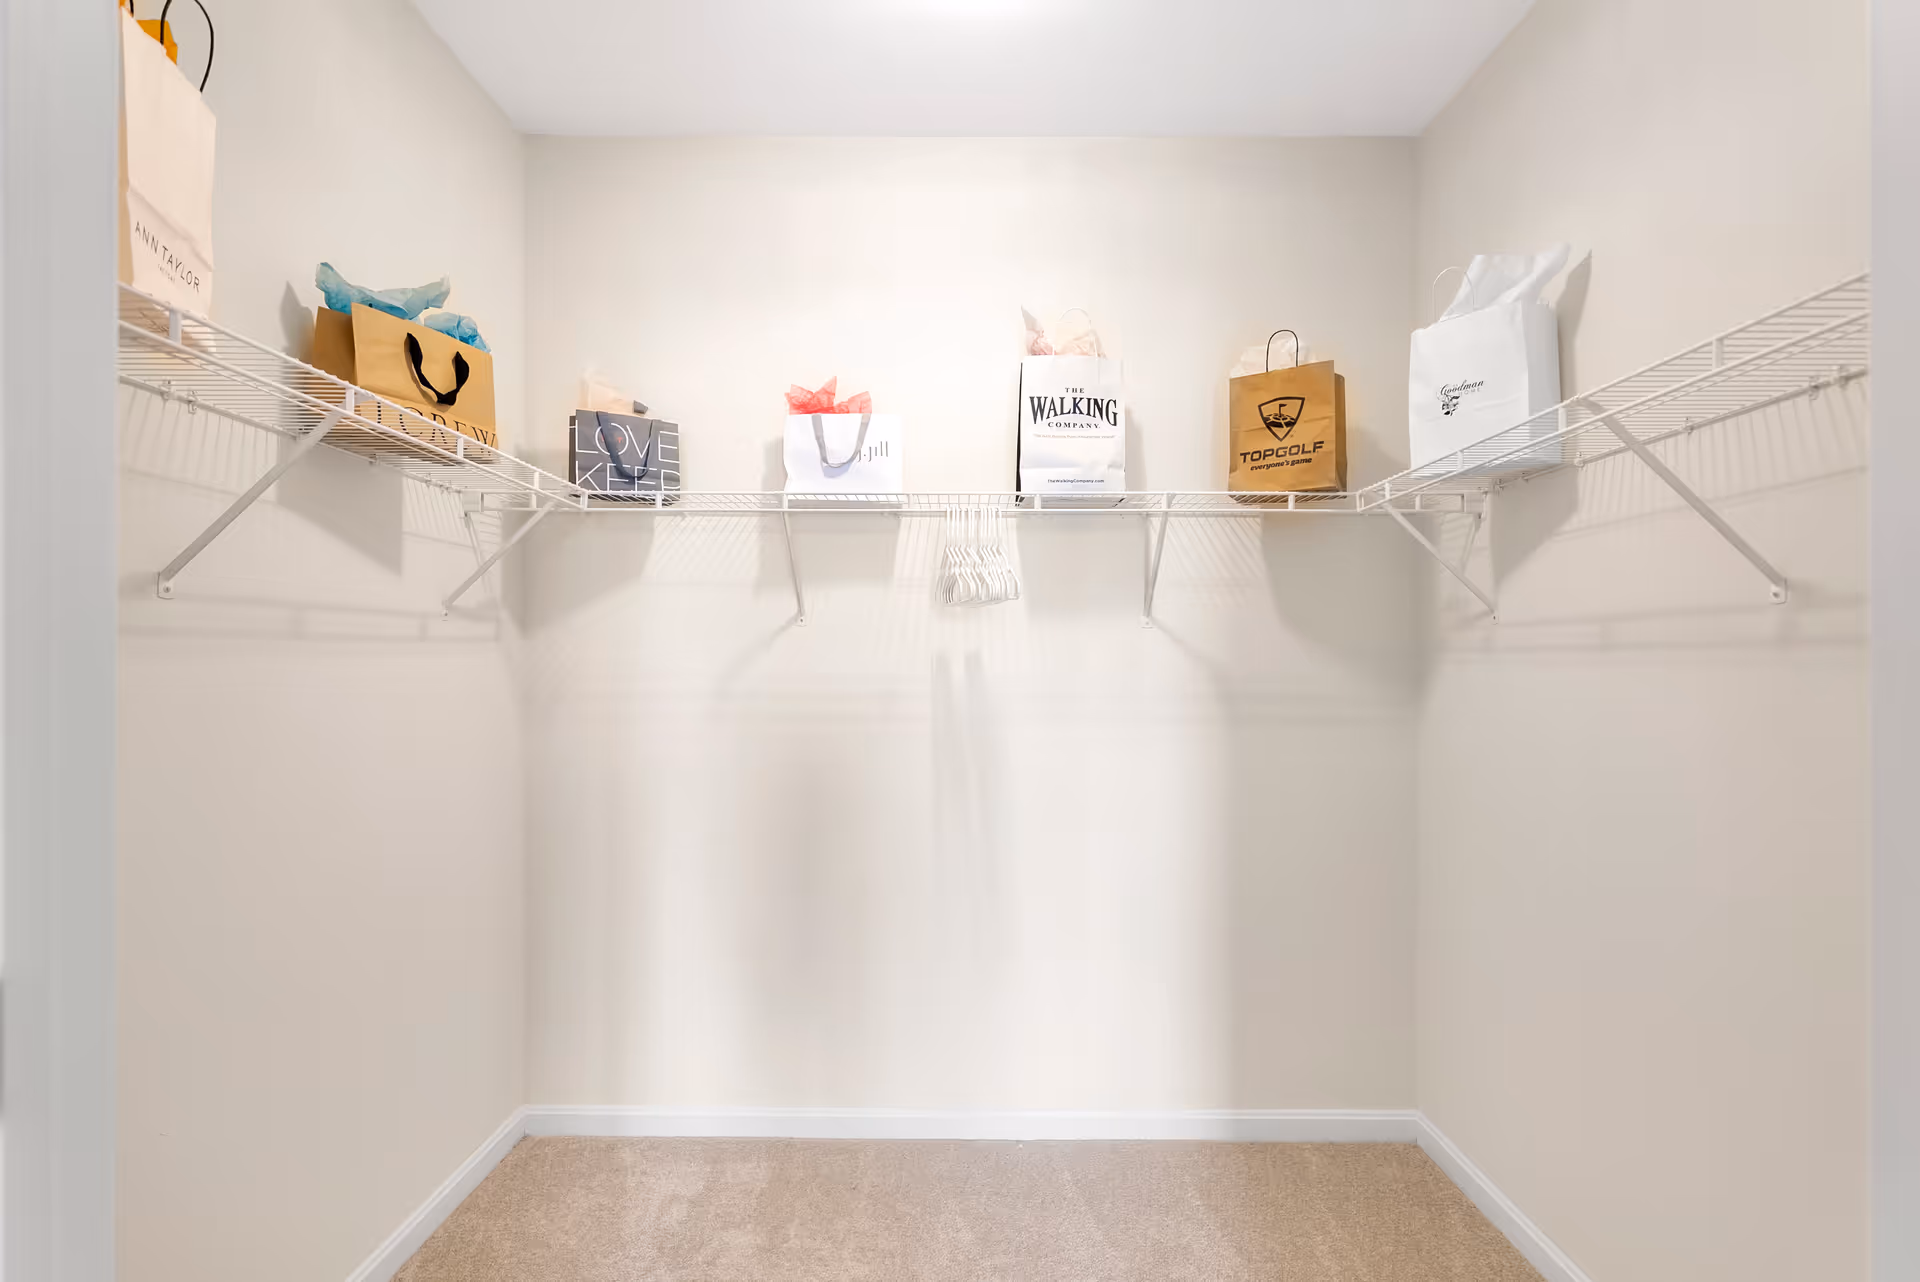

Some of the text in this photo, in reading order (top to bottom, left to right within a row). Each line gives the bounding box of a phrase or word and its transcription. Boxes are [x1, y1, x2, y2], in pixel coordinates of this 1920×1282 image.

[135, 220, 159, 254] ANN
[162, 245, 200, 294] TAYLOR
[1029, 396, 1118, 427] WALKING
[576, 420, 680, 463] LOVE
[1239, 440, 1325, 463] TOPGOLF
[575, 460, 681, 499] KEEP
[1250, 457, 1313, 471] everyone's game
